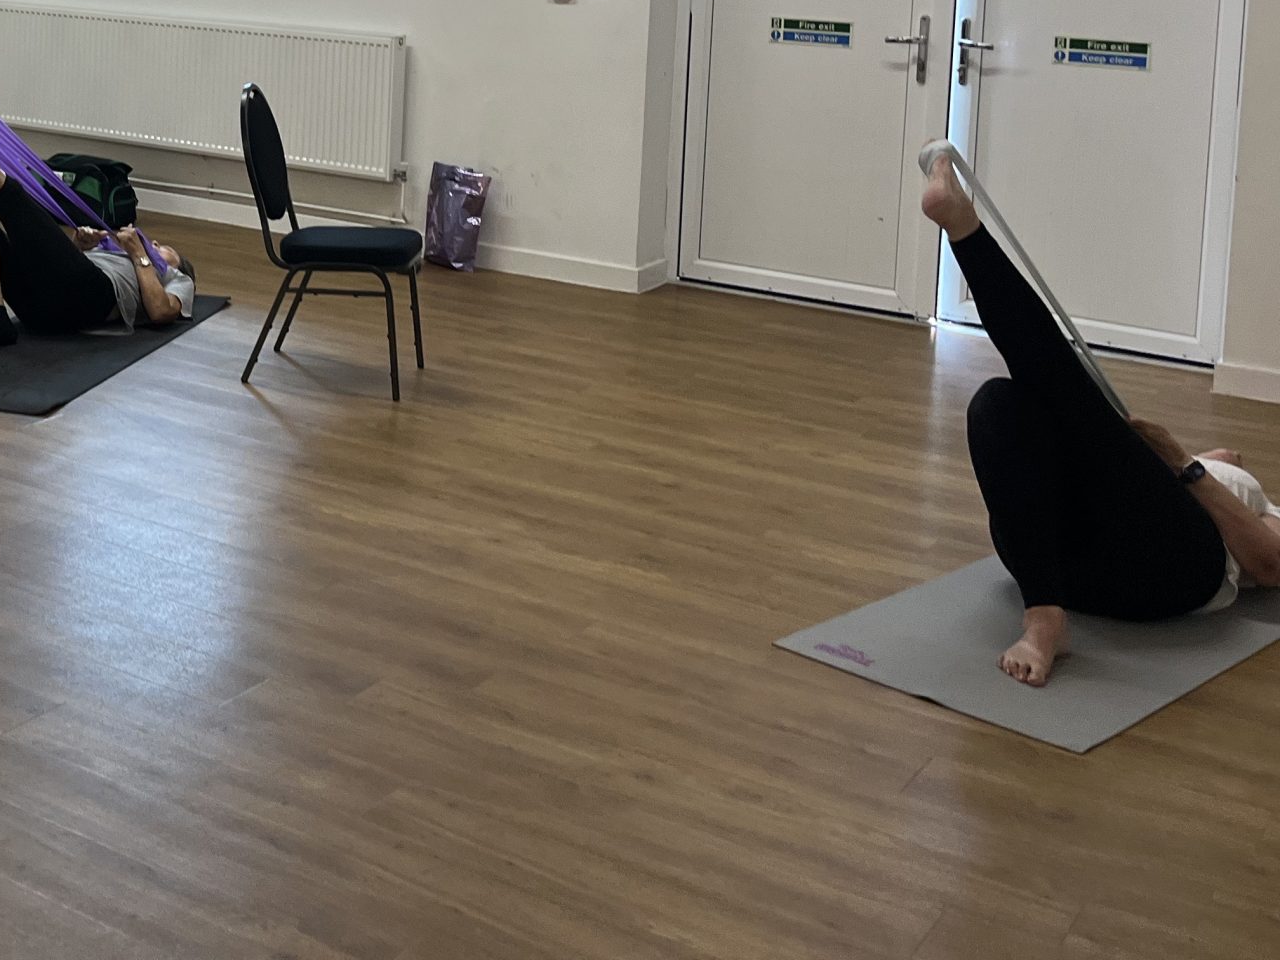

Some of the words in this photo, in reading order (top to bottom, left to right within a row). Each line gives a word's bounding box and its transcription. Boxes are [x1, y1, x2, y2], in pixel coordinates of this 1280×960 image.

[799, 21, 816, 29] Fire
[818, 23, 835, 31] exit
[794, 32, 815, 43] Keep
[817, 34, 838, 43] clear
[1087, 41, 1107, 50] Fire
[1110, 43, 1130, 52] exit
[1081, 54, 1107, 64] Keep
[1109, 56, 1133, 65] clear
